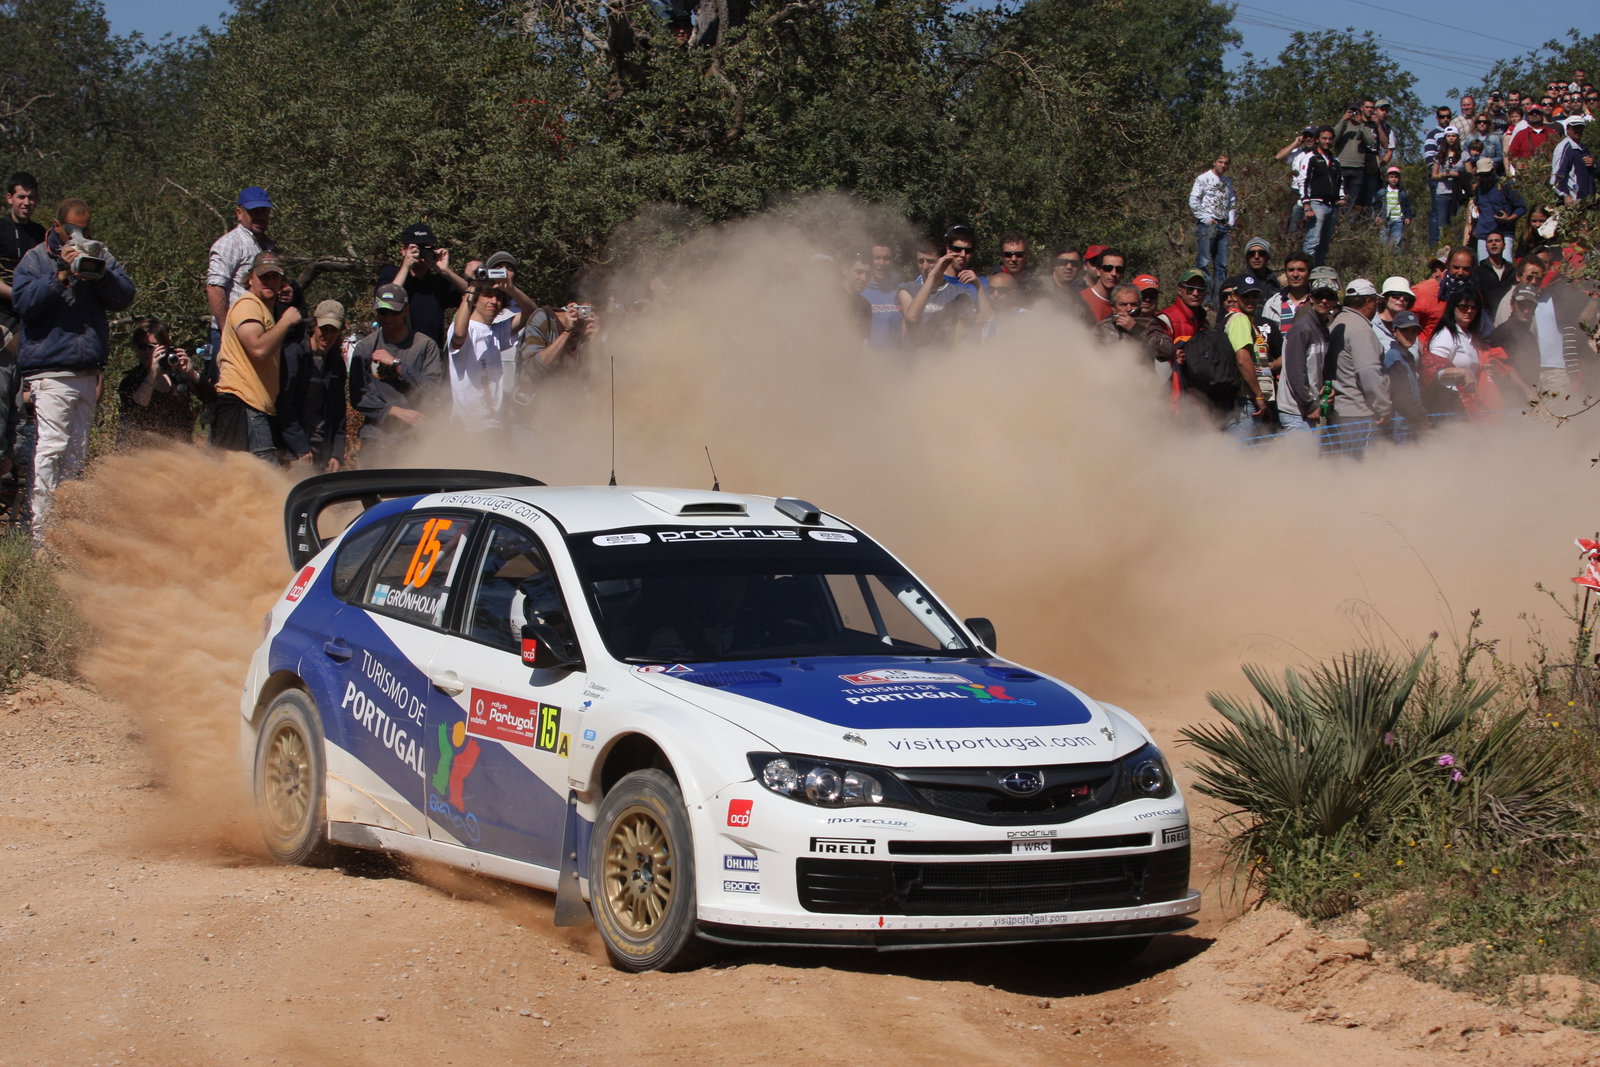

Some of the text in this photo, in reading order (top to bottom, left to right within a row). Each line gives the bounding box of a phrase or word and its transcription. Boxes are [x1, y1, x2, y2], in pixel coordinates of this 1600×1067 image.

[440, 494, 541, 523] visitportugal.com
[657, 527, 801, 543] prodrive
[403, 517, 452, 589] 15
[362, 649, 426, 727] TURISMO DE
[840, 685, 915, 695] TURISMO
[845, 692, 968, 705] PORTUGAL
[489, 708, 534, 731] Portugal
[540, 706, 558, 749] 15
[341, 680, 426, 779] PORTUGAL
[558, 735, 568, 757] A
[888, 735, 1097, 753] visitportugal.com
[1006, 829, 1058, 839] prodrive
[809, 836, 876, 854] PIRELLI
[1015, 842, 1049, 852] 1 WRC
[726, 855, 760, 870] ÖHLINS
[724, 881, 760, 892] sparco
